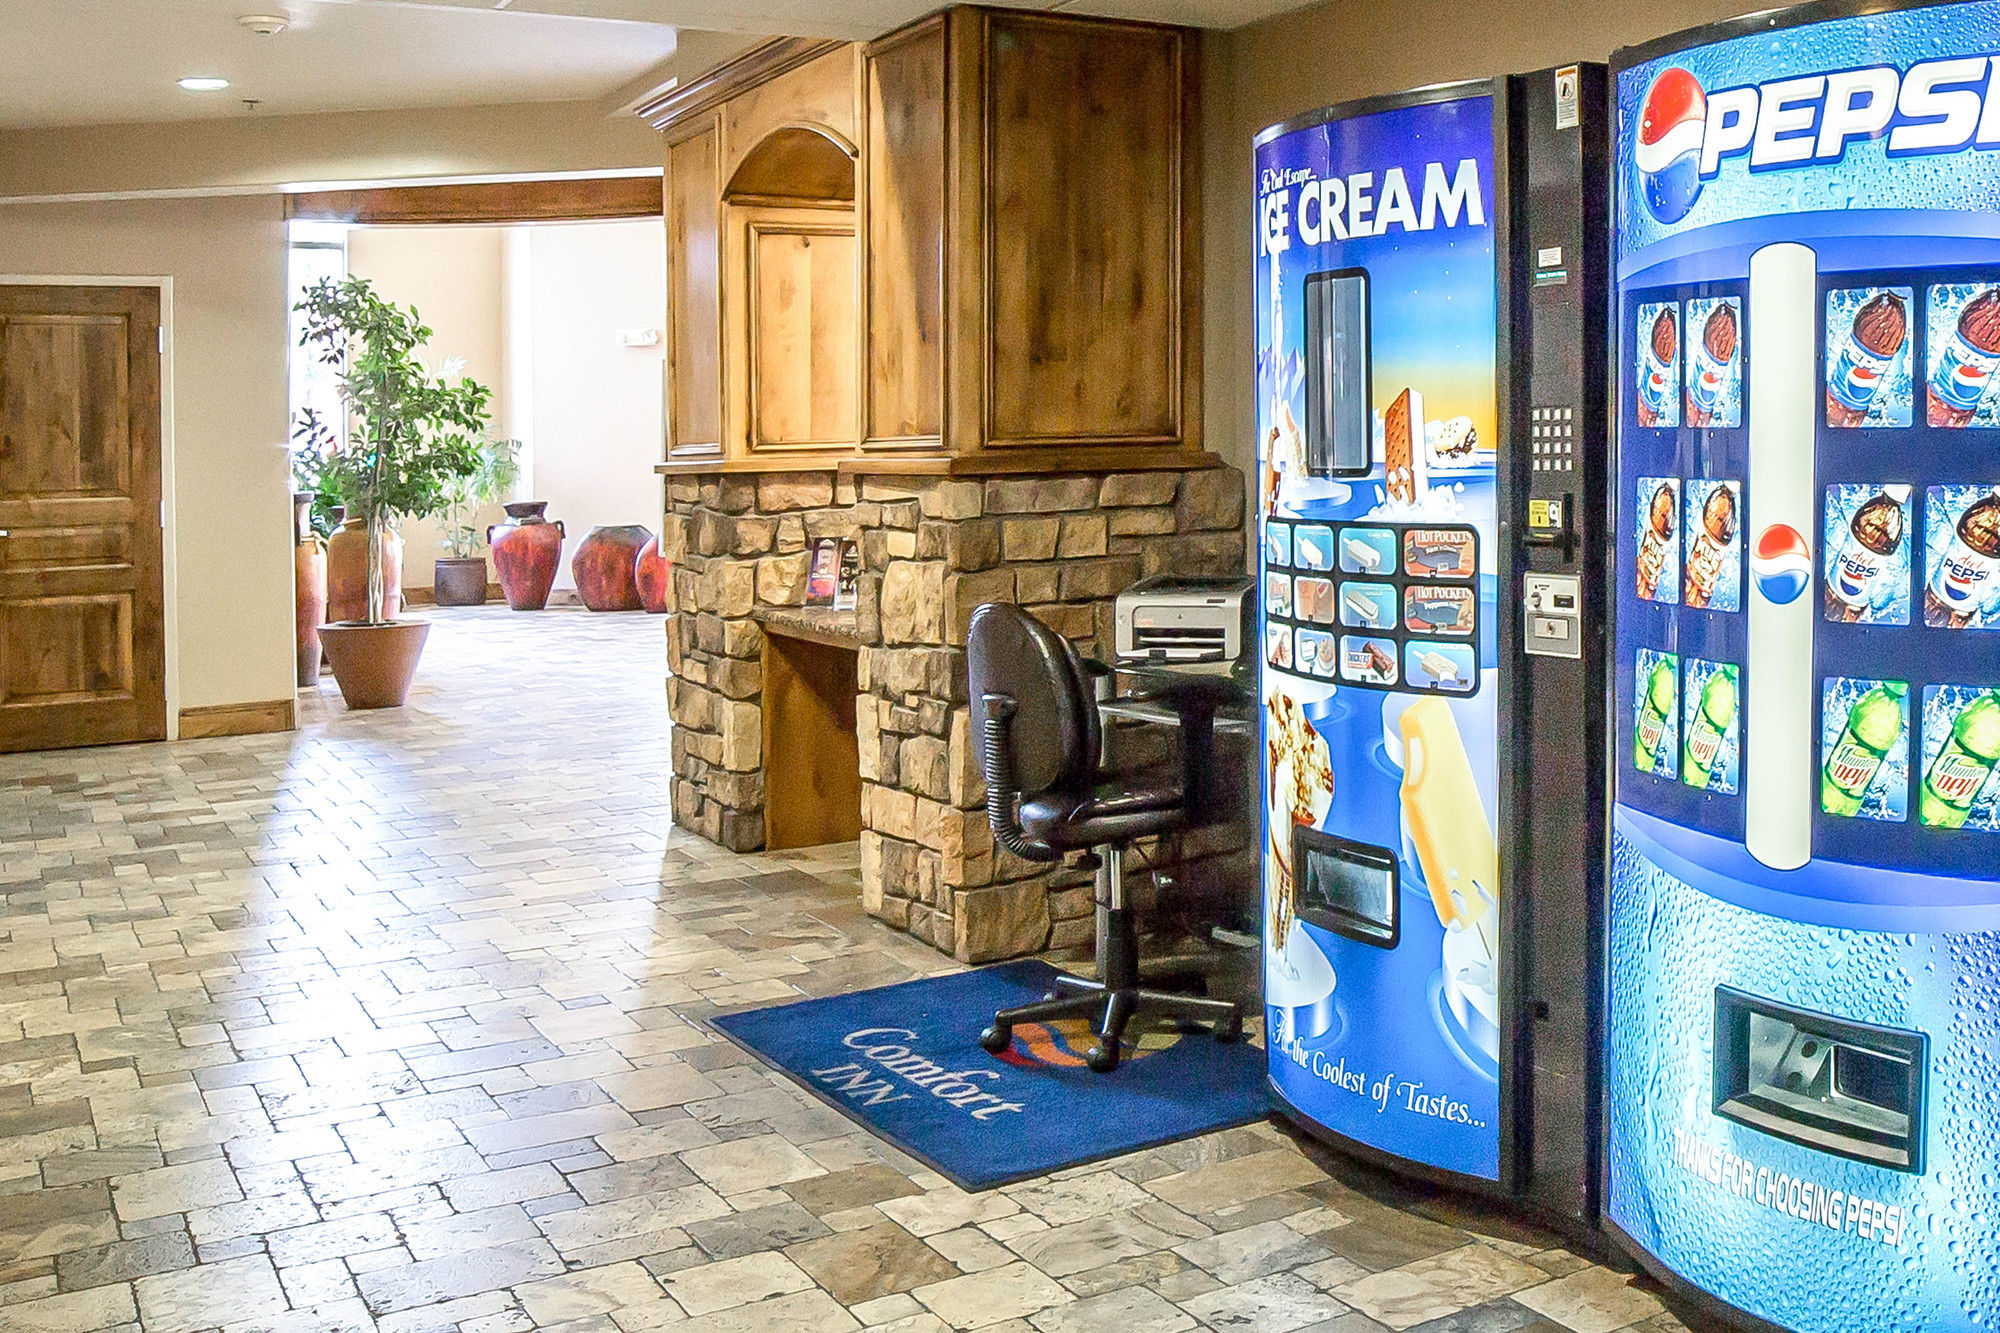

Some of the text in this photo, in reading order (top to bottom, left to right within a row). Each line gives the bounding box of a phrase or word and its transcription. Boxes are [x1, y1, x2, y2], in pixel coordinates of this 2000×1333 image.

[1260, 158, 1484, 257] ICE CREAM
[1416, 530, 1435, 542] HOT
[1838, 554, 1880, 578] PEPSI
[1944, 558, 1990, 581] PEPSI
[1416, 586, 1435, 598] HOT
[811, 1063, 912, 1106] INN
[842, 1028, 1025, 1120] Comfort
[1292, 1036, 1309, 1068] the
[1312, 1051, 1366, 1095] Coolest
[1372, 1074, 1394, 1114] of
[1396, 1081, 1486, 1128] Tastes...
[1721, 1151, 1754, 1200] FOR
[1755, 1166, 1844, 1231] CHOOSING
[1843, 1194, 1906, 1247] PEPSI
